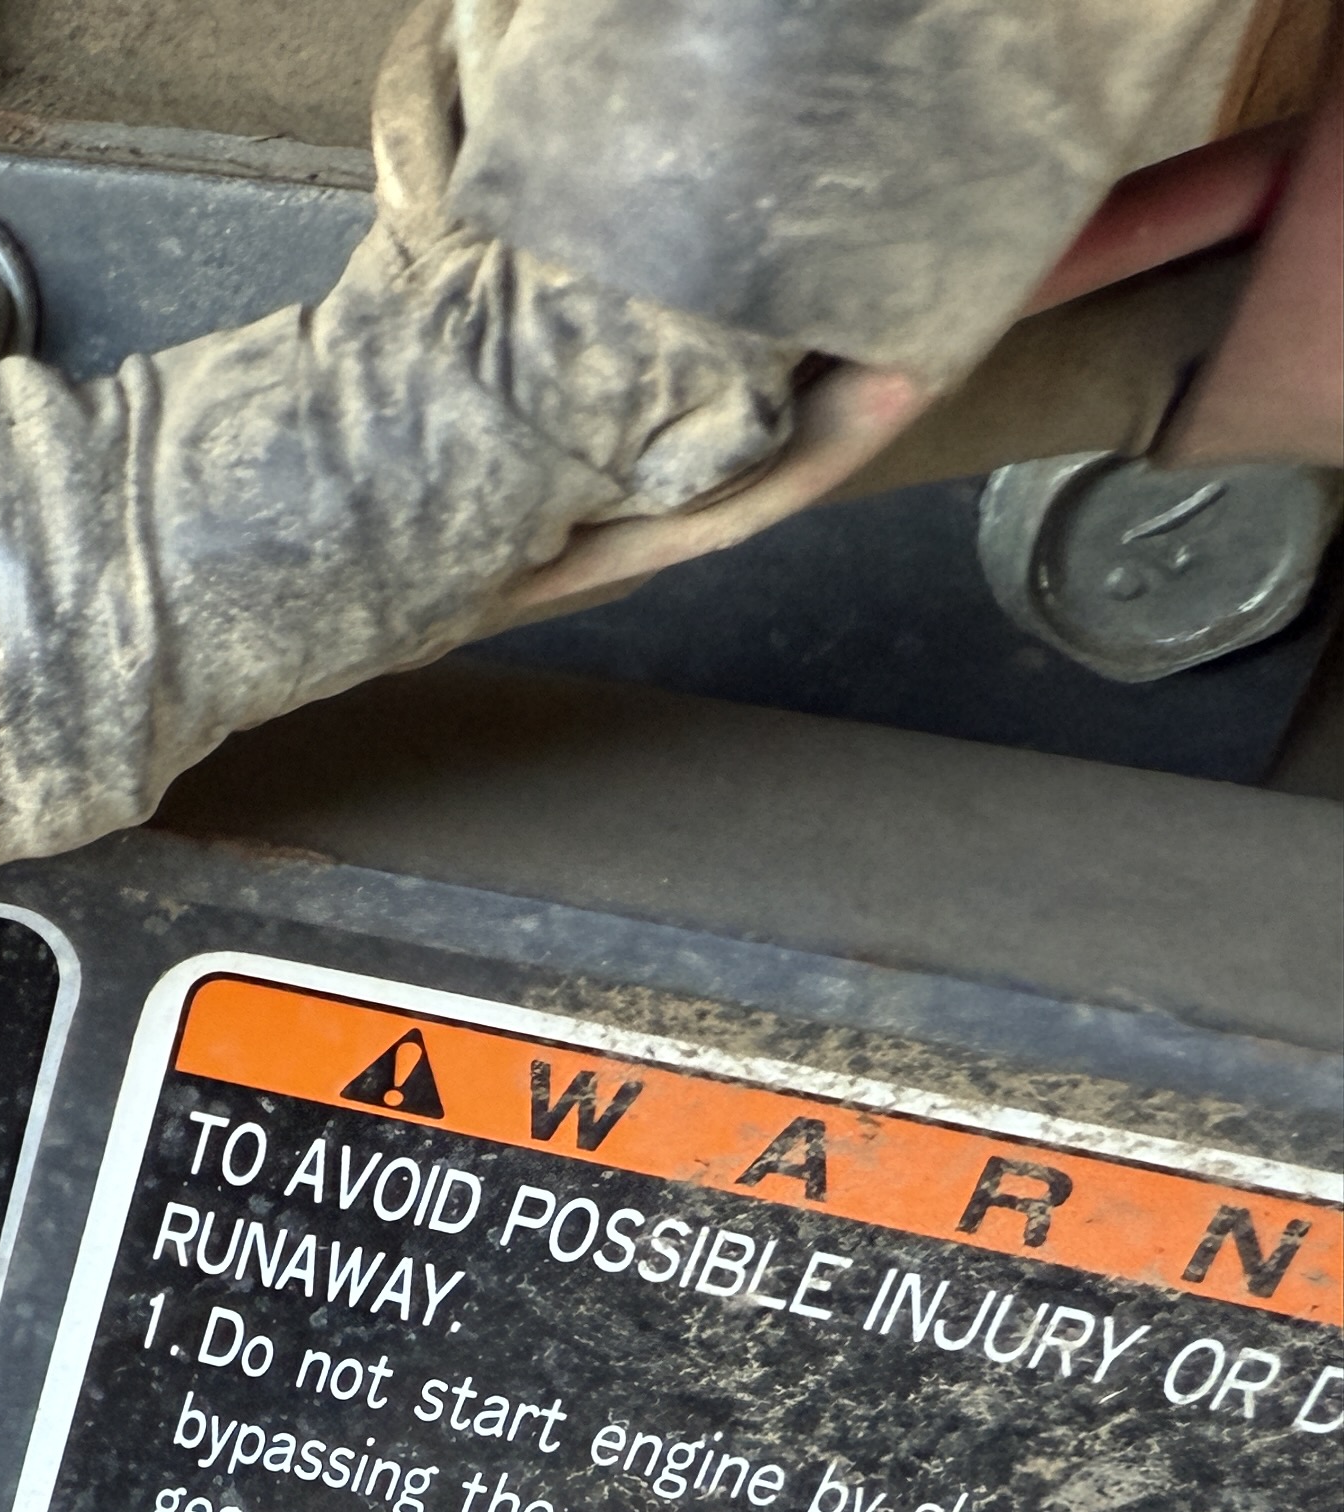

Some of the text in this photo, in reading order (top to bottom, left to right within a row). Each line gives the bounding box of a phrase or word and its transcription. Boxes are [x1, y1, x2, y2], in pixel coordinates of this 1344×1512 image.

[152, 1201, 466, 1335] RUNAWAY.
[189, 1110, 268, 1187] TO
[283, 1138, 482, 1236] AVOID
[499, 1184, 854, 1321] POSSIBLE
[863, 1267, 1153, 1385] INJURY
[1162, 1338, 1283, 1419] OR
[197, 1306, 273, 1378] Do
[296, 1347, 393, 1409] not
[414, 1377, 566, 1454] start
[590, 1422, 785, 1504] engine
